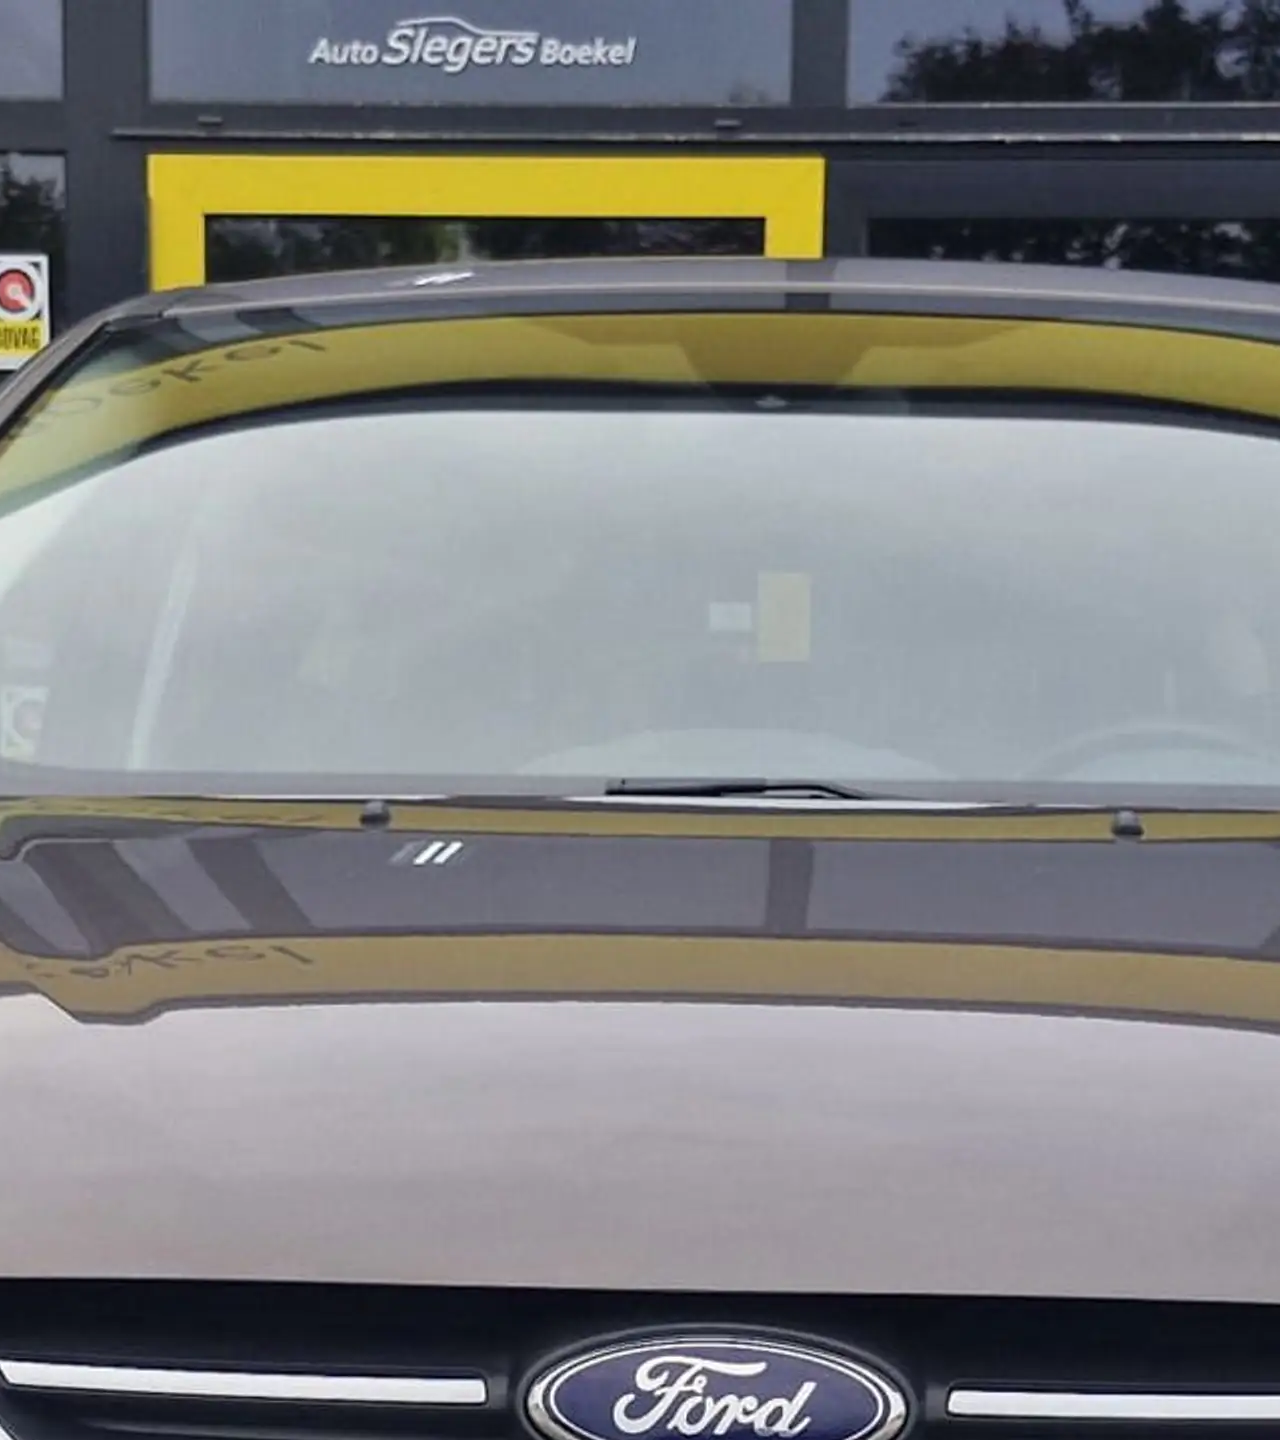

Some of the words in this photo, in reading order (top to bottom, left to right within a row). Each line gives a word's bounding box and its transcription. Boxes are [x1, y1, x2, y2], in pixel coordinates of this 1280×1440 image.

[308, 37, 378, 65] Auto
[381, 27, 539, 73] Slegers
[540, 37, 637, 65] Boekel
[612, 1354, 818, 1438] Ford
